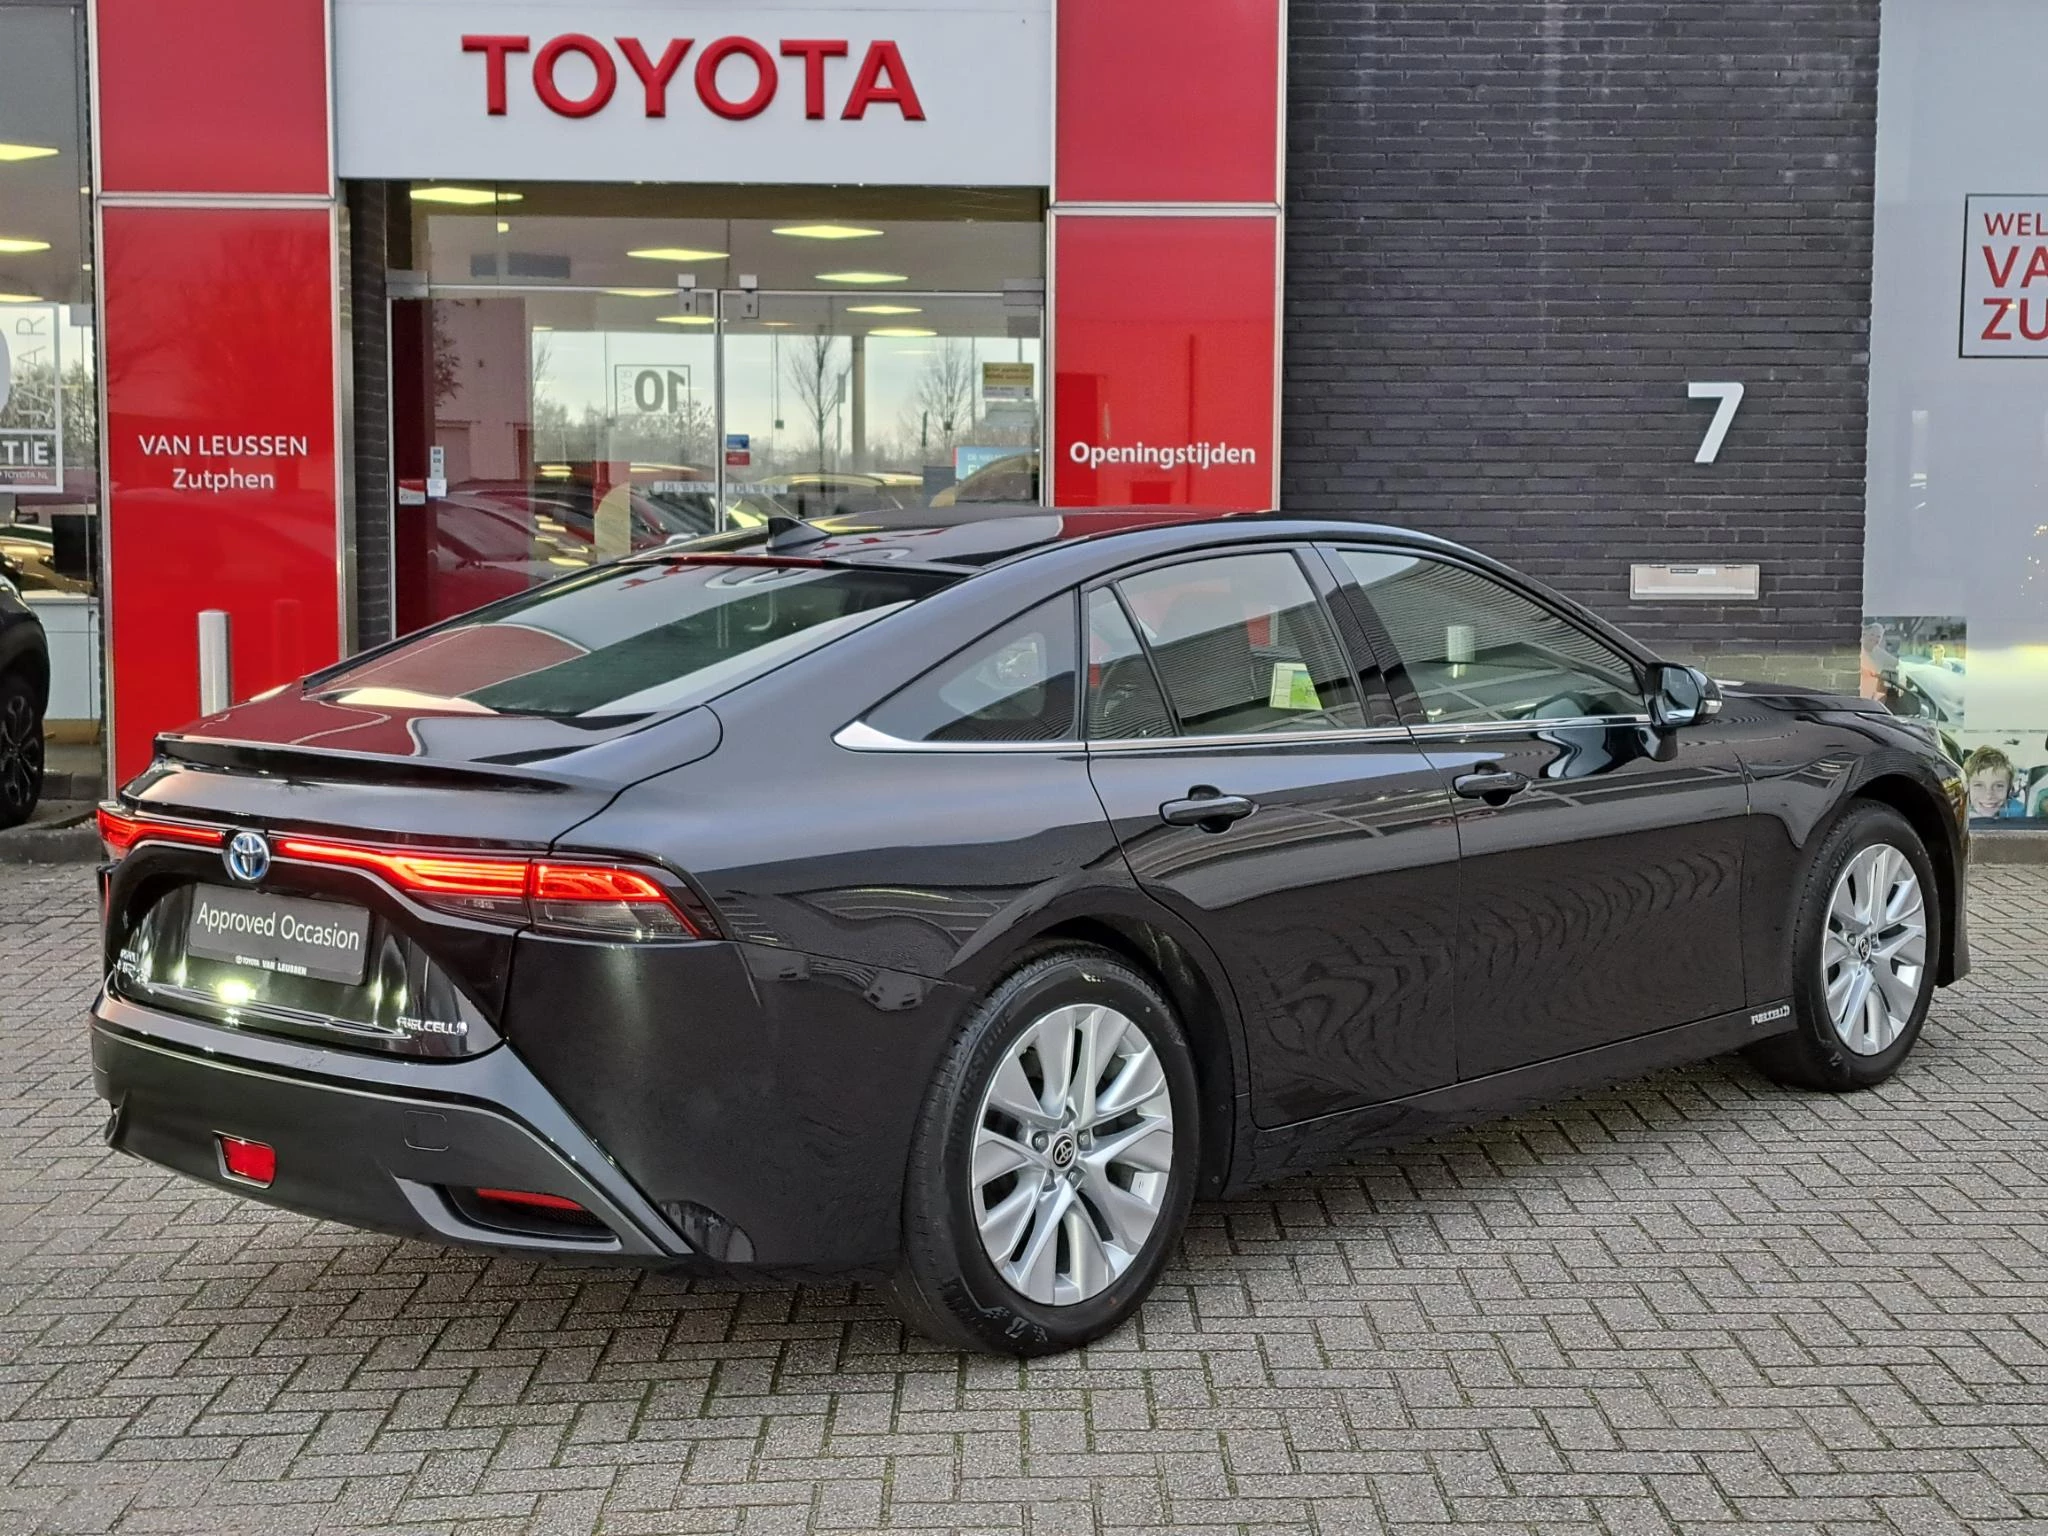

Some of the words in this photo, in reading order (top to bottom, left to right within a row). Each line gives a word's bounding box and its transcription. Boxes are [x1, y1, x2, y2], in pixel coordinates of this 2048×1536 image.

[461, 32, 926, 121] TOYOTA
[1981, 297, 2048, 341] ZU
[1688, 382, 1745, 464] 7
[2, 440, 50, 465] TIE
[139, 435, 190, 456] VAN
[199, 435, 307, 457] LEUSSEN
[1070, 441, 1256, 469] Openingstijden
[172, 468, 274, 493] Zutphen
[196, 901, 276, 937] Approved
[280, 914, 360, 951] Occasion
[262, 959, 276, 970] VAN
